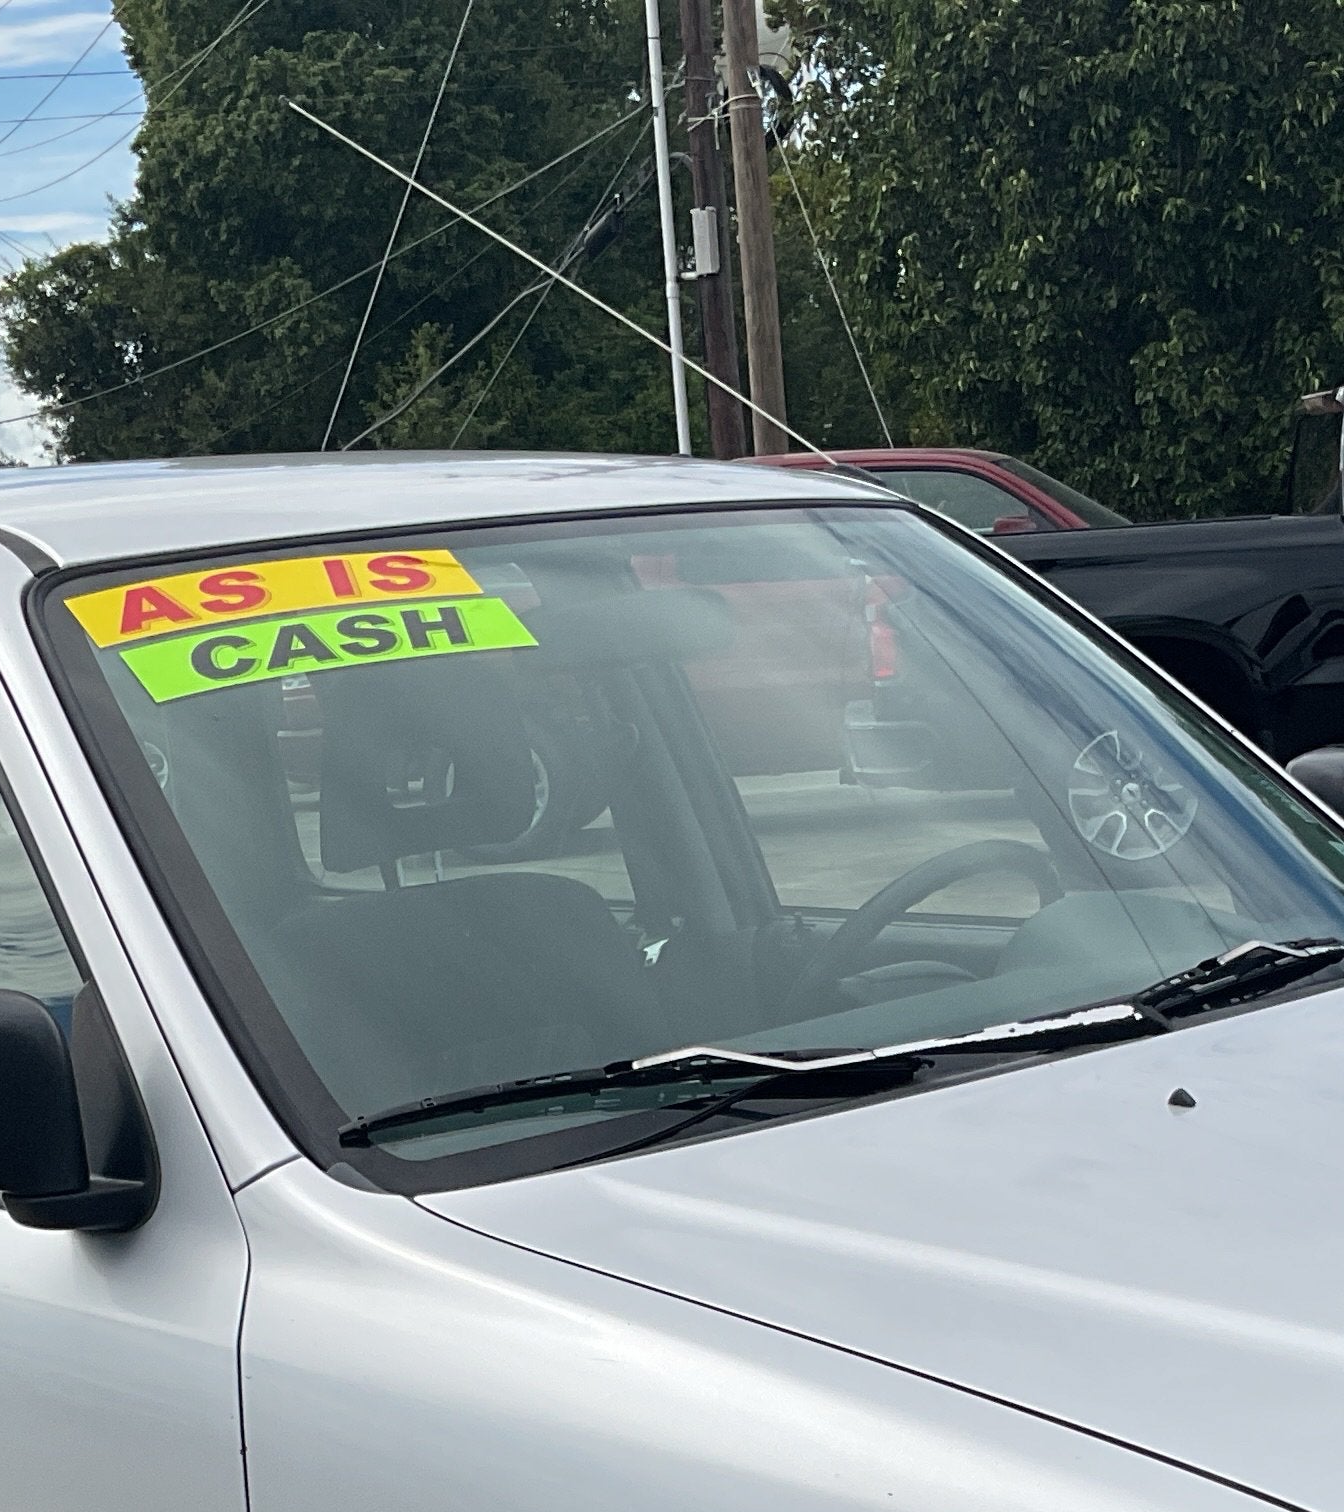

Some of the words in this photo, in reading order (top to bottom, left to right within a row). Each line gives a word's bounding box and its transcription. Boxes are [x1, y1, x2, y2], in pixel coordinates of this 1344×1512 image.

[120, 570, 271, 635] AS
[323, 555, 437, 598] IS
[189, 605, 472, 682] CASH
